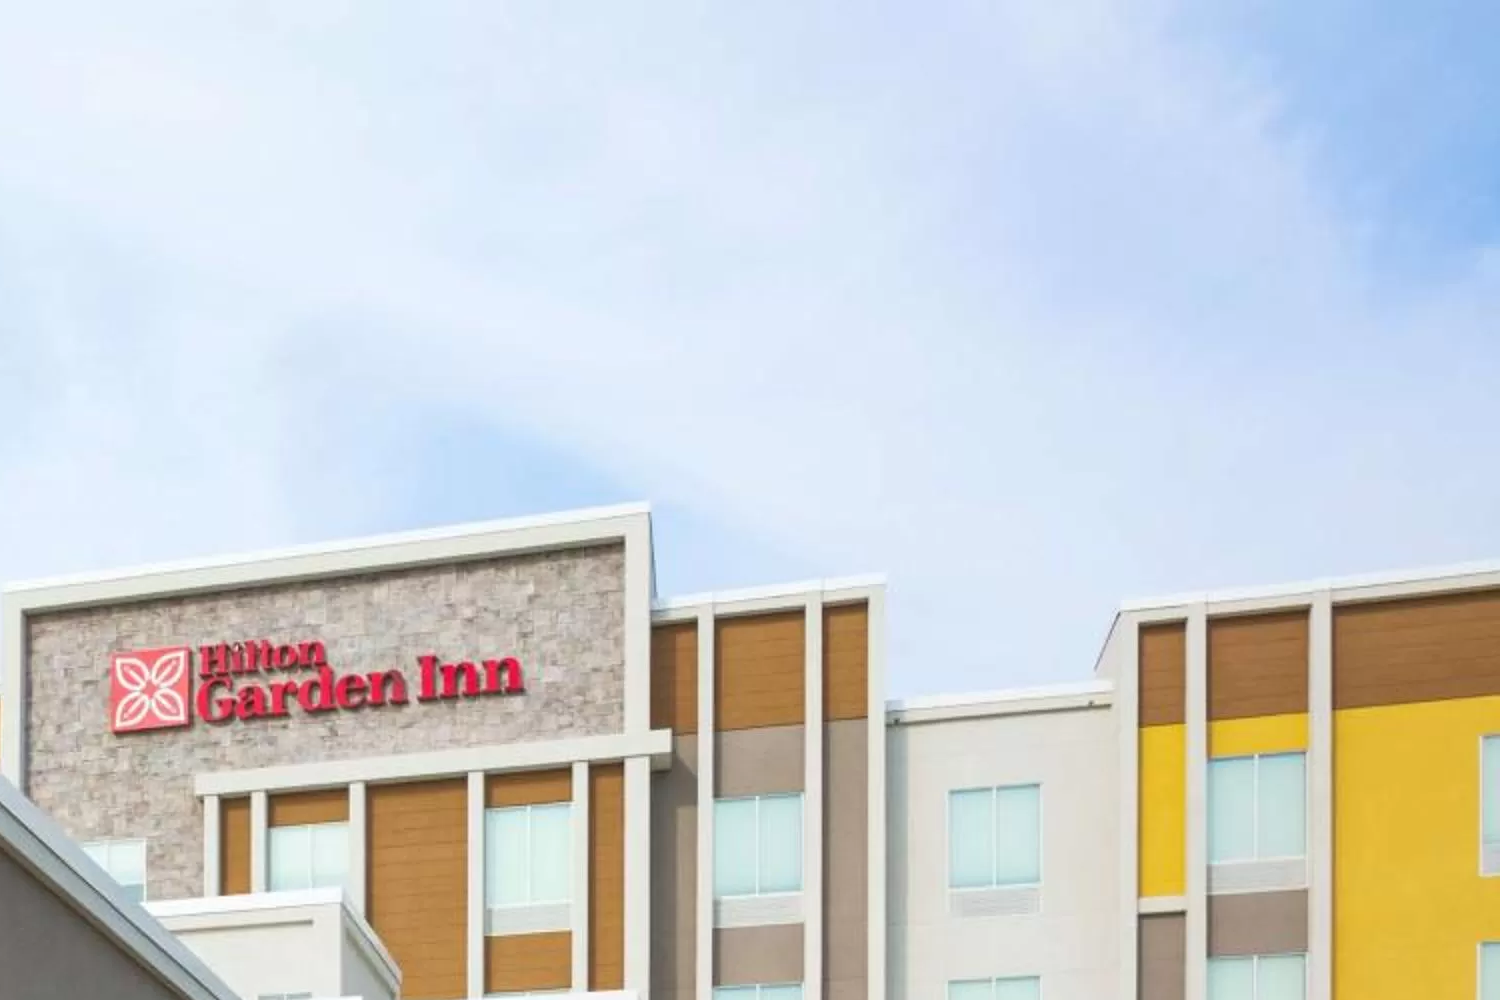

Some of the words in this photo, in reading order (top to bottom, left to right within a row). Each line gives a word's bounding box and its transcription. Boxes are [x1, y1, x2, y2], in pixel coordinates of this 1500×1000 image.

[198, 639, 326, 678] Hilton
[197, 664, 408, 724] Garden
[417, 654, 526, 702] Inn
